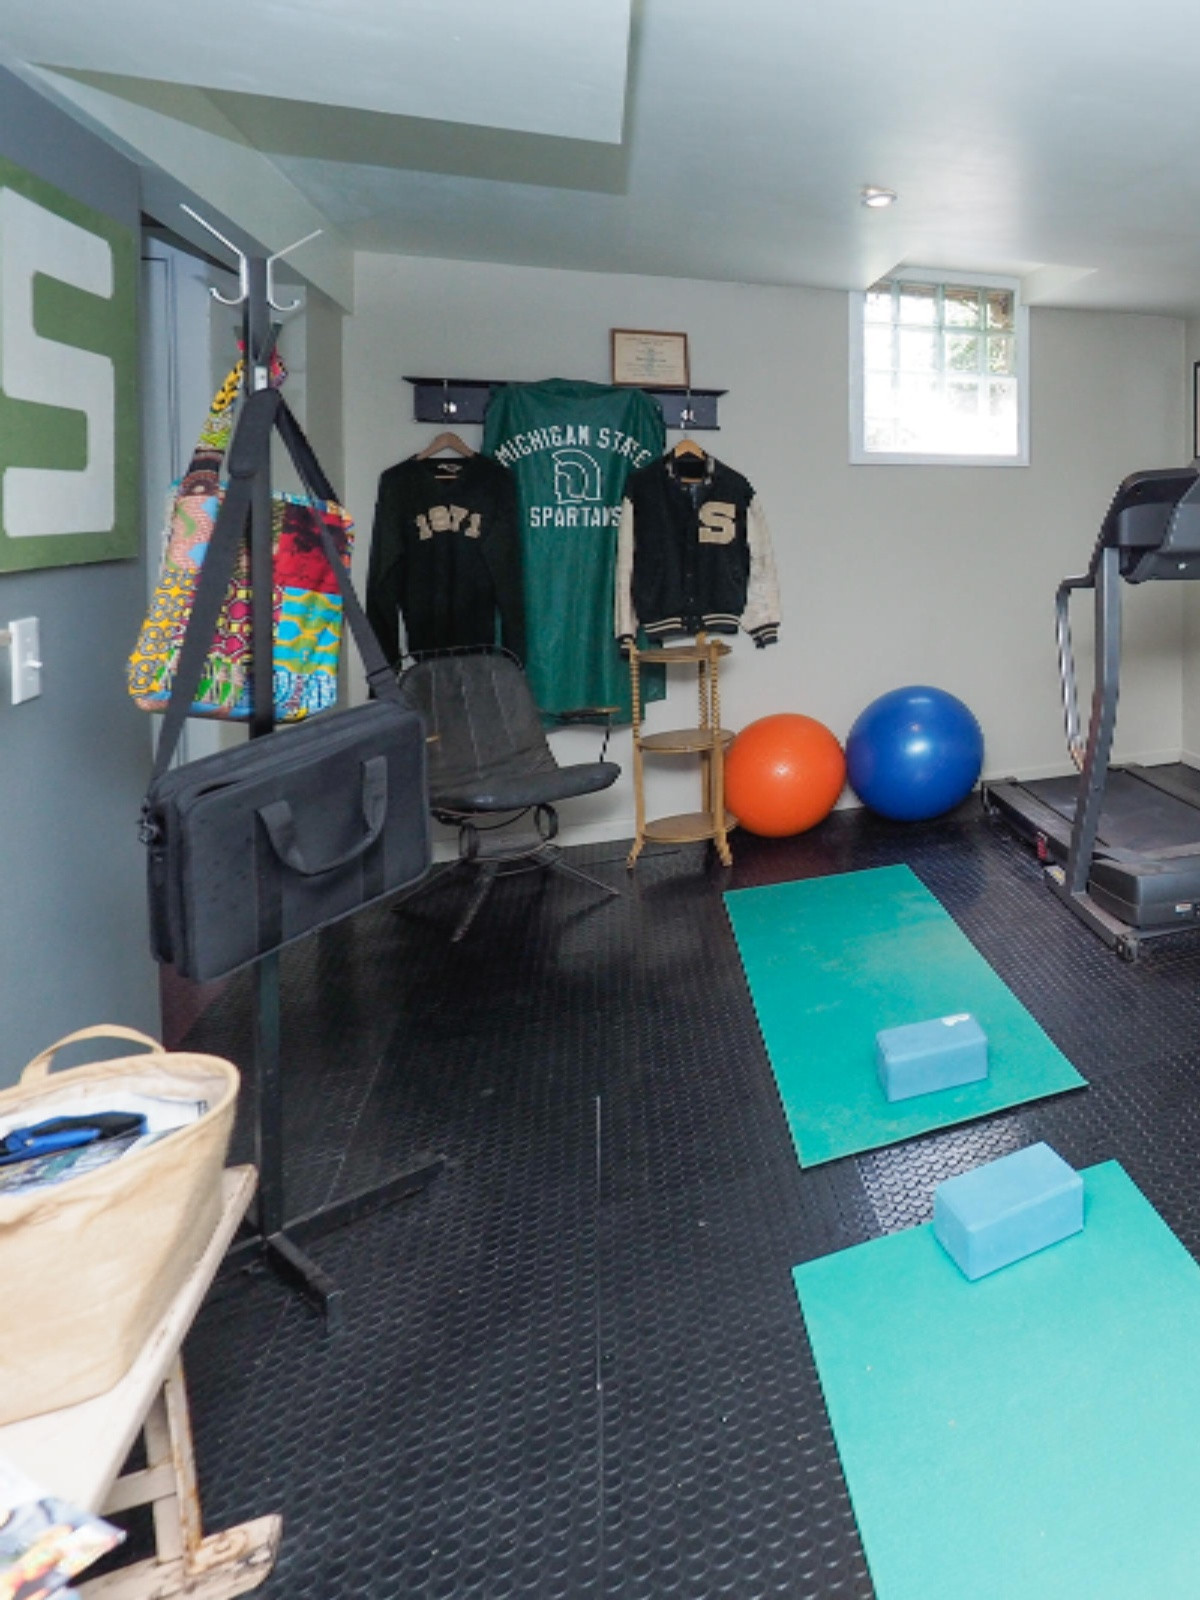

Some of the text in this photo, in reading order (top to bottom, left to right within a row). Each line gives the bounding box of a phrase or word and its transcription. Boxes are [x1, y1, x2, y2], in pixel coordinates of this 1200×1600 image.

[1, 186, 115, 538] S
[494, 424, 652, 469] MICHIGAN STATE
[530, 506, 622, 527] SPARTANS
[698, 501, 736, 545] S
